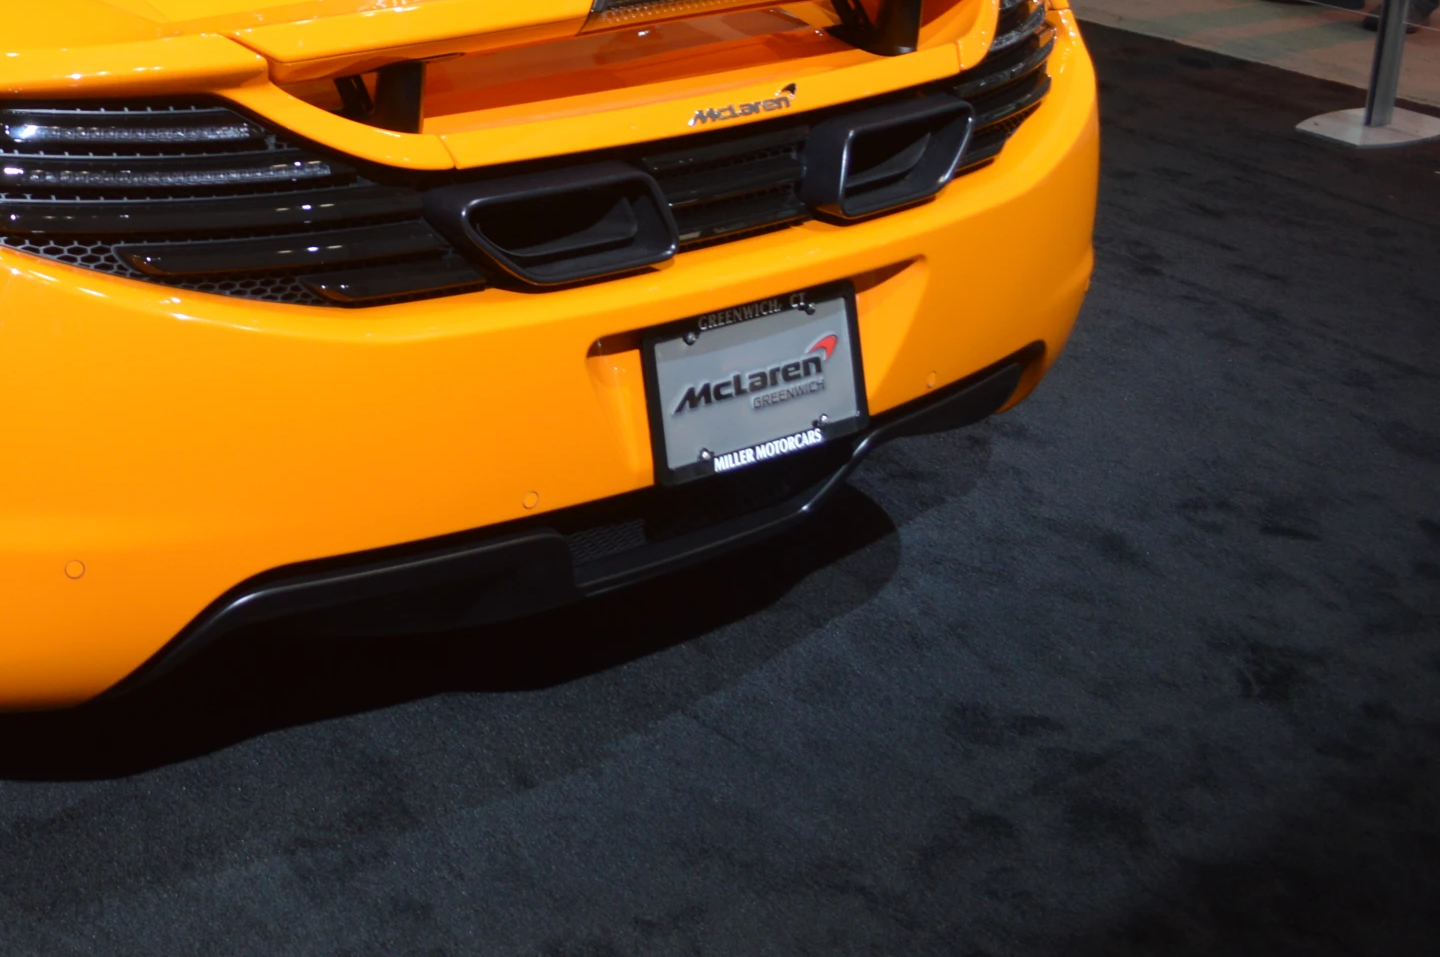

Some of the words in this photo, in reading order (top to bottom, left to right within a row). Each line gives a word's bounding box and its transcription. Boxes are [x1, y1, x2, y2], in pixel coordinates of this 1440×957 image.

[688, 96, 791, 127] McLaren
[789, 291, 806, 308] CT
[672, 355, 823, 416] McLaren
[752, 378, 826, 410] GREENWICH
[713, 448, 756, 472] MILLER
[755, 428, 823, 461] MOTORCARS
